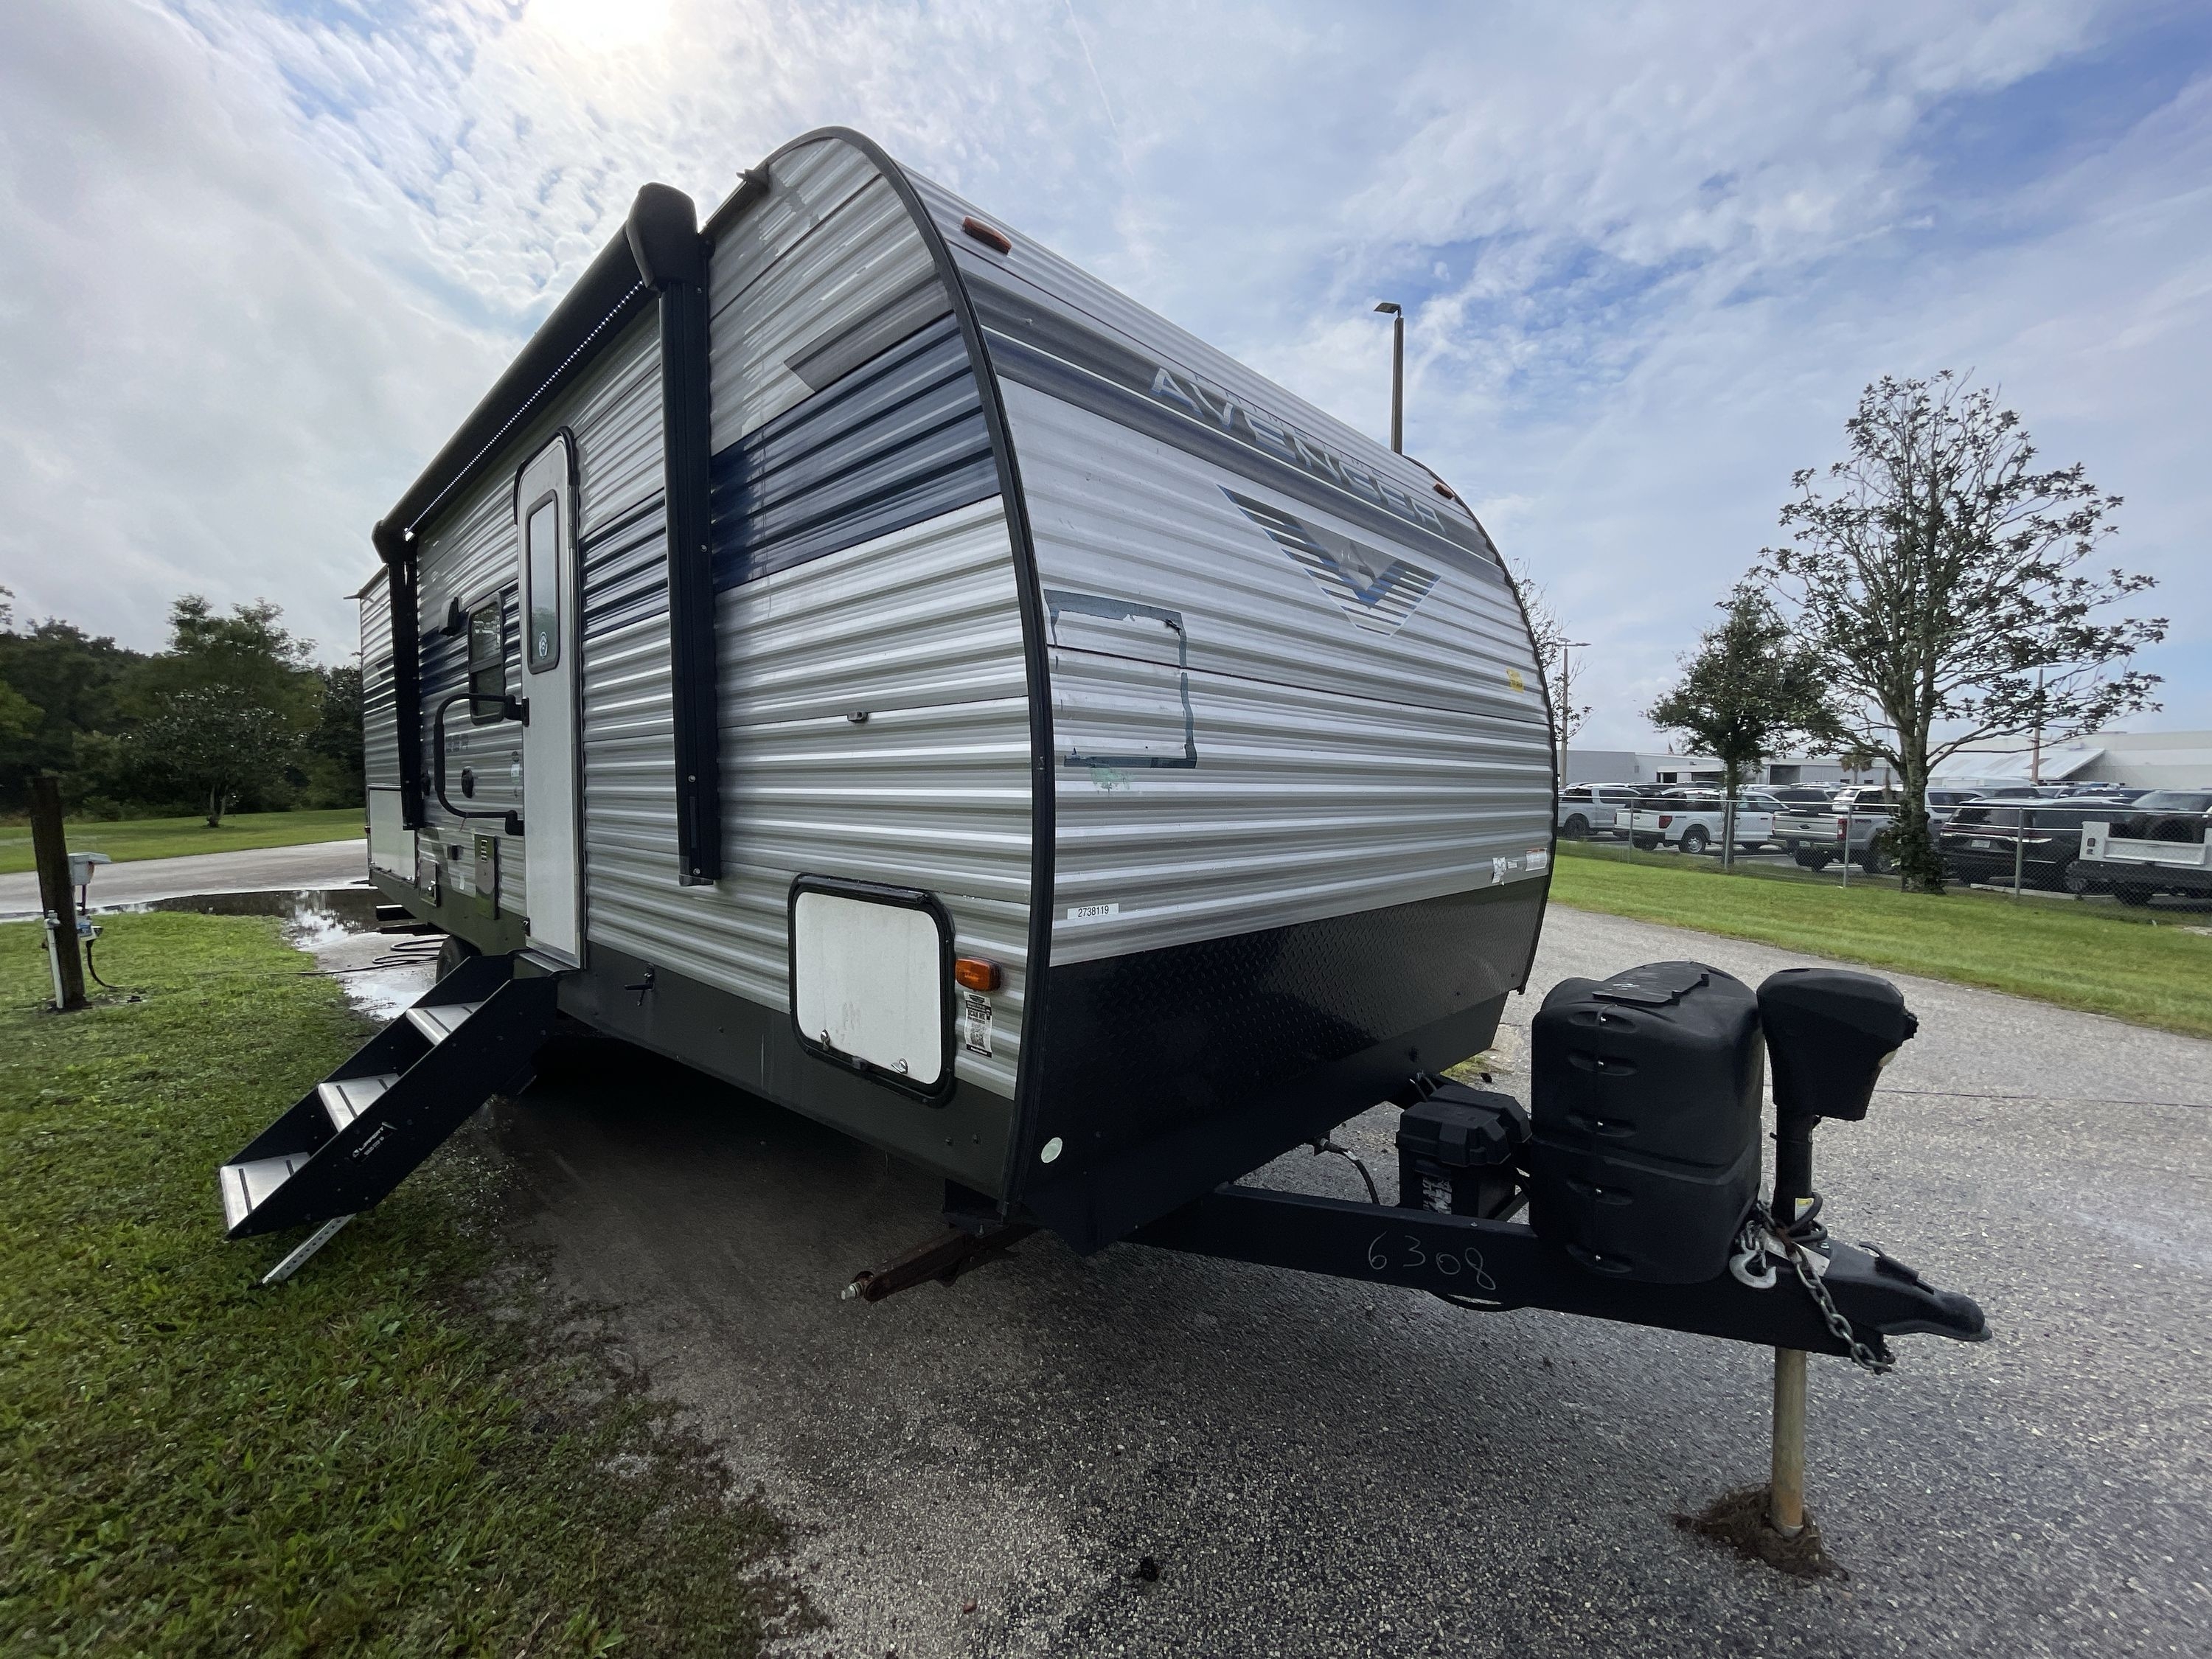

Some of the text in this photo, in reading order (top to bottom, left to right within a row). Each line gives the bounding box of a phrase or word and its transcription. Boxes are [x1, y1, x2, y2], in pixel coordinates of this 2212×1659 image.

[1150, 367, 1447, 535] AVENGER
[1078, 905, 1109, 917] 2738119
[1368, 1230, 1497, 1291] 6308
